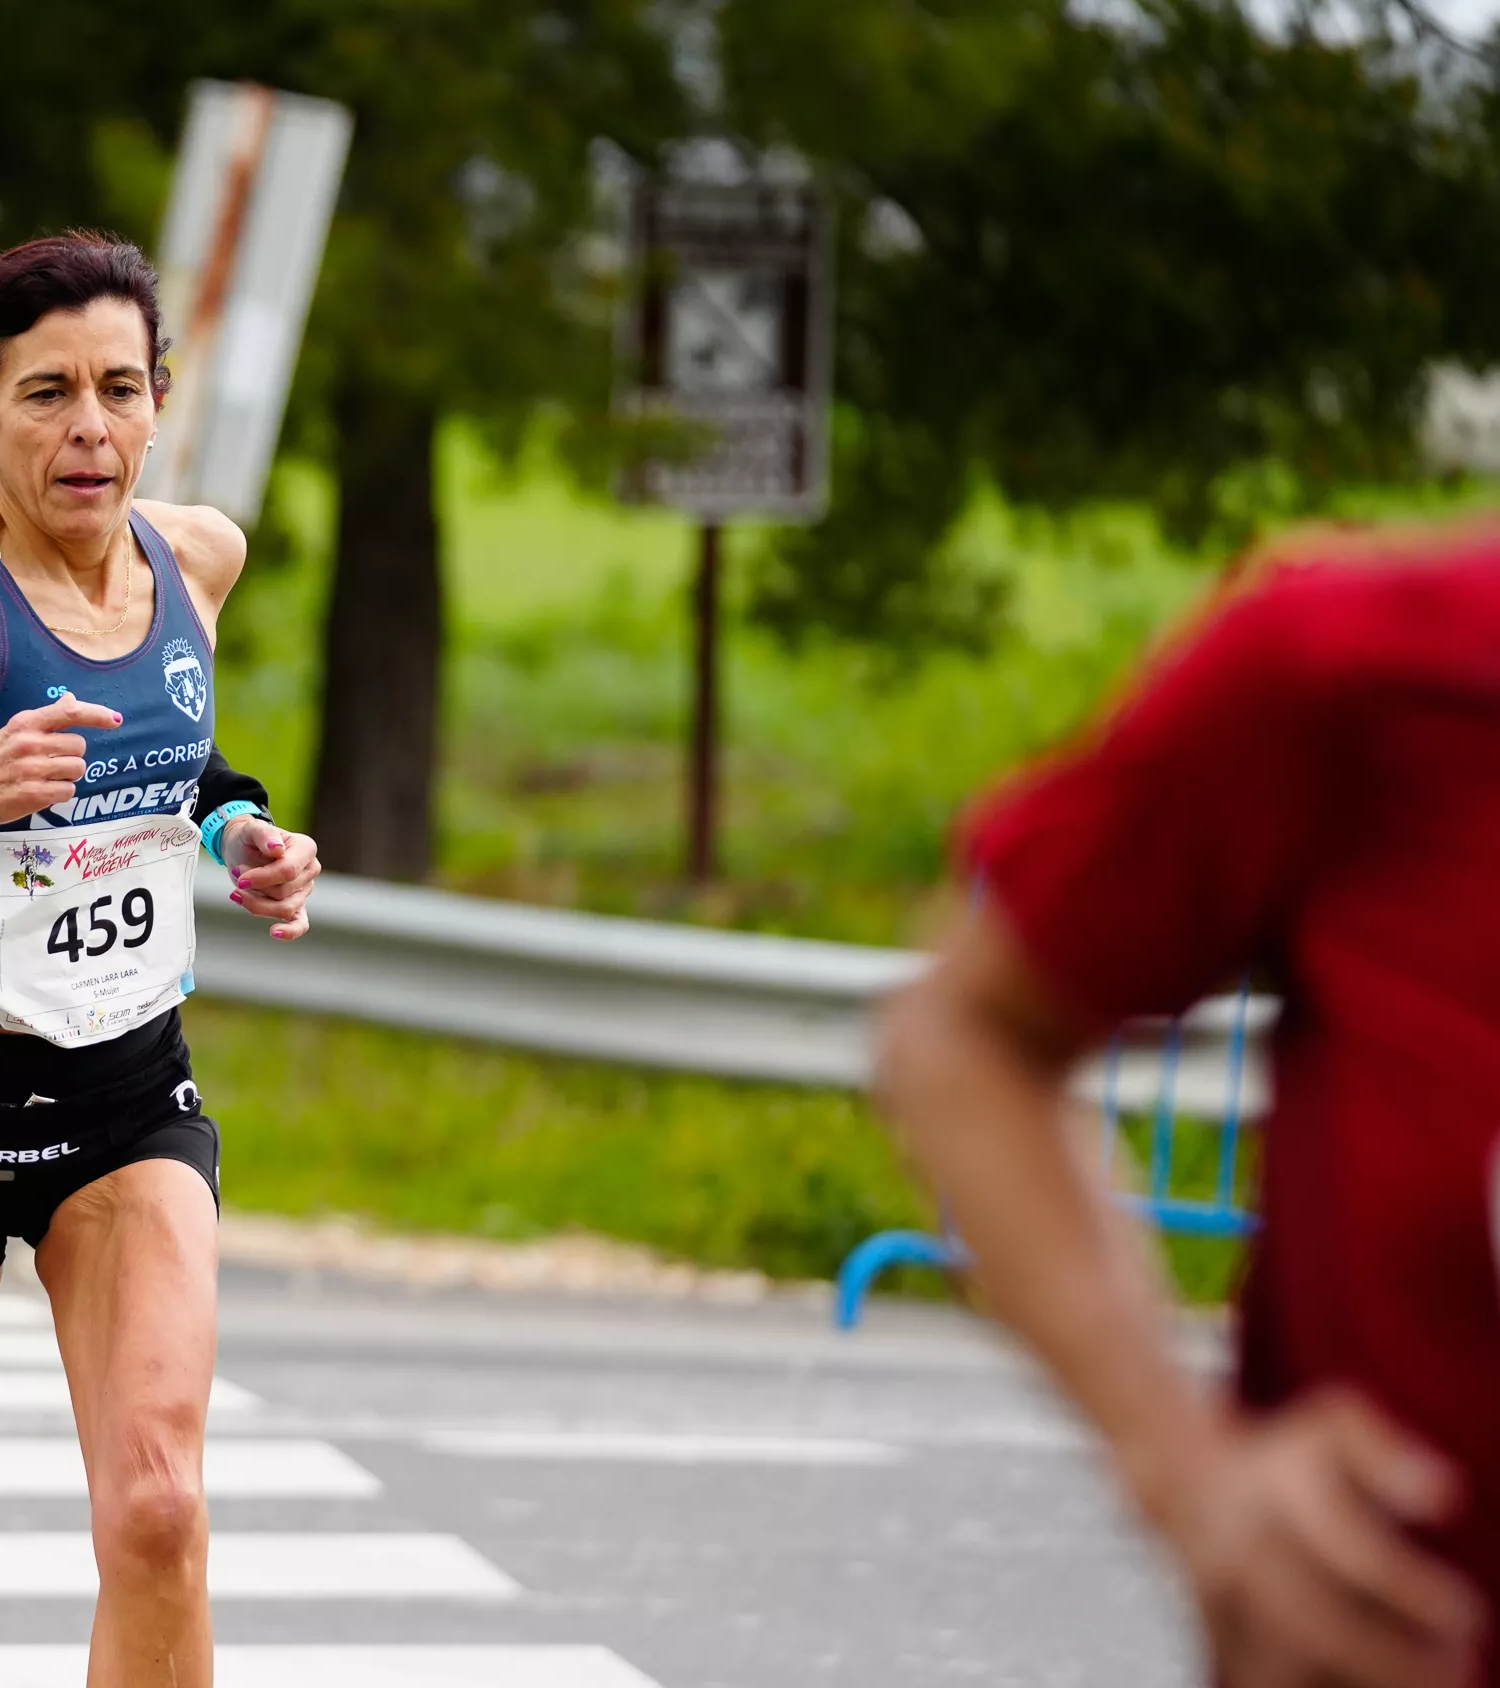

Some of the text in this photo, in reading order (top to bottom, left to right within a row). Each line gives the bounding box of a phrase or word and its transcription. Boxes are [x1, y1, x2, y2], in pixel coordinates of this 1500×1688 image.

[122, 754, 138, 772] A
[143, 737, 212, 767] CORRER
[63, 838, 88, 871] X
[47, 887, 155, 963] 459
[71, 968, 139, 991] CARMEN LARA LARA
